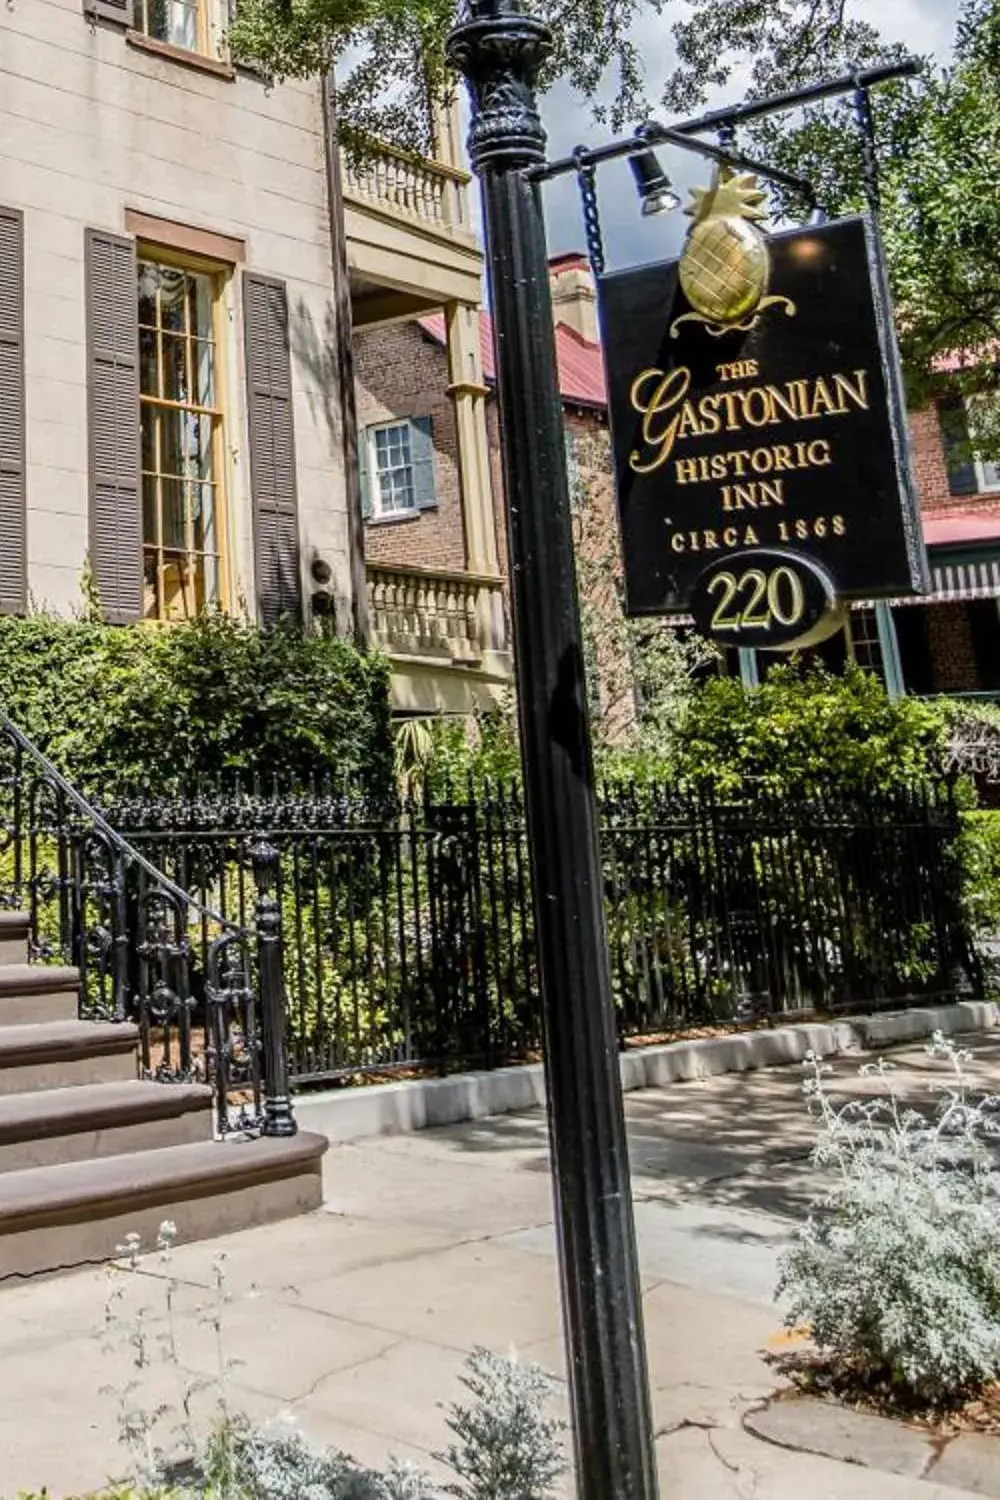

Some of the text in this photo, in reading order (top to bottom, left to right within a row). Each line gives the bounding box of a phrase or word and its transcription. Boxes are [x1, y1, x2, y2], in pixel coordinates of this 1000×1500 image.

[715, 358, 760, 381] THE
[629, 366, 870, 473] GASTONIAN
[675, 438, 832, 485] HISTORIC
[720, 479, 785, 512] INN
[671, 515, 847, 553] CIRCA 1868
[707, 566, 804, 633] 220
